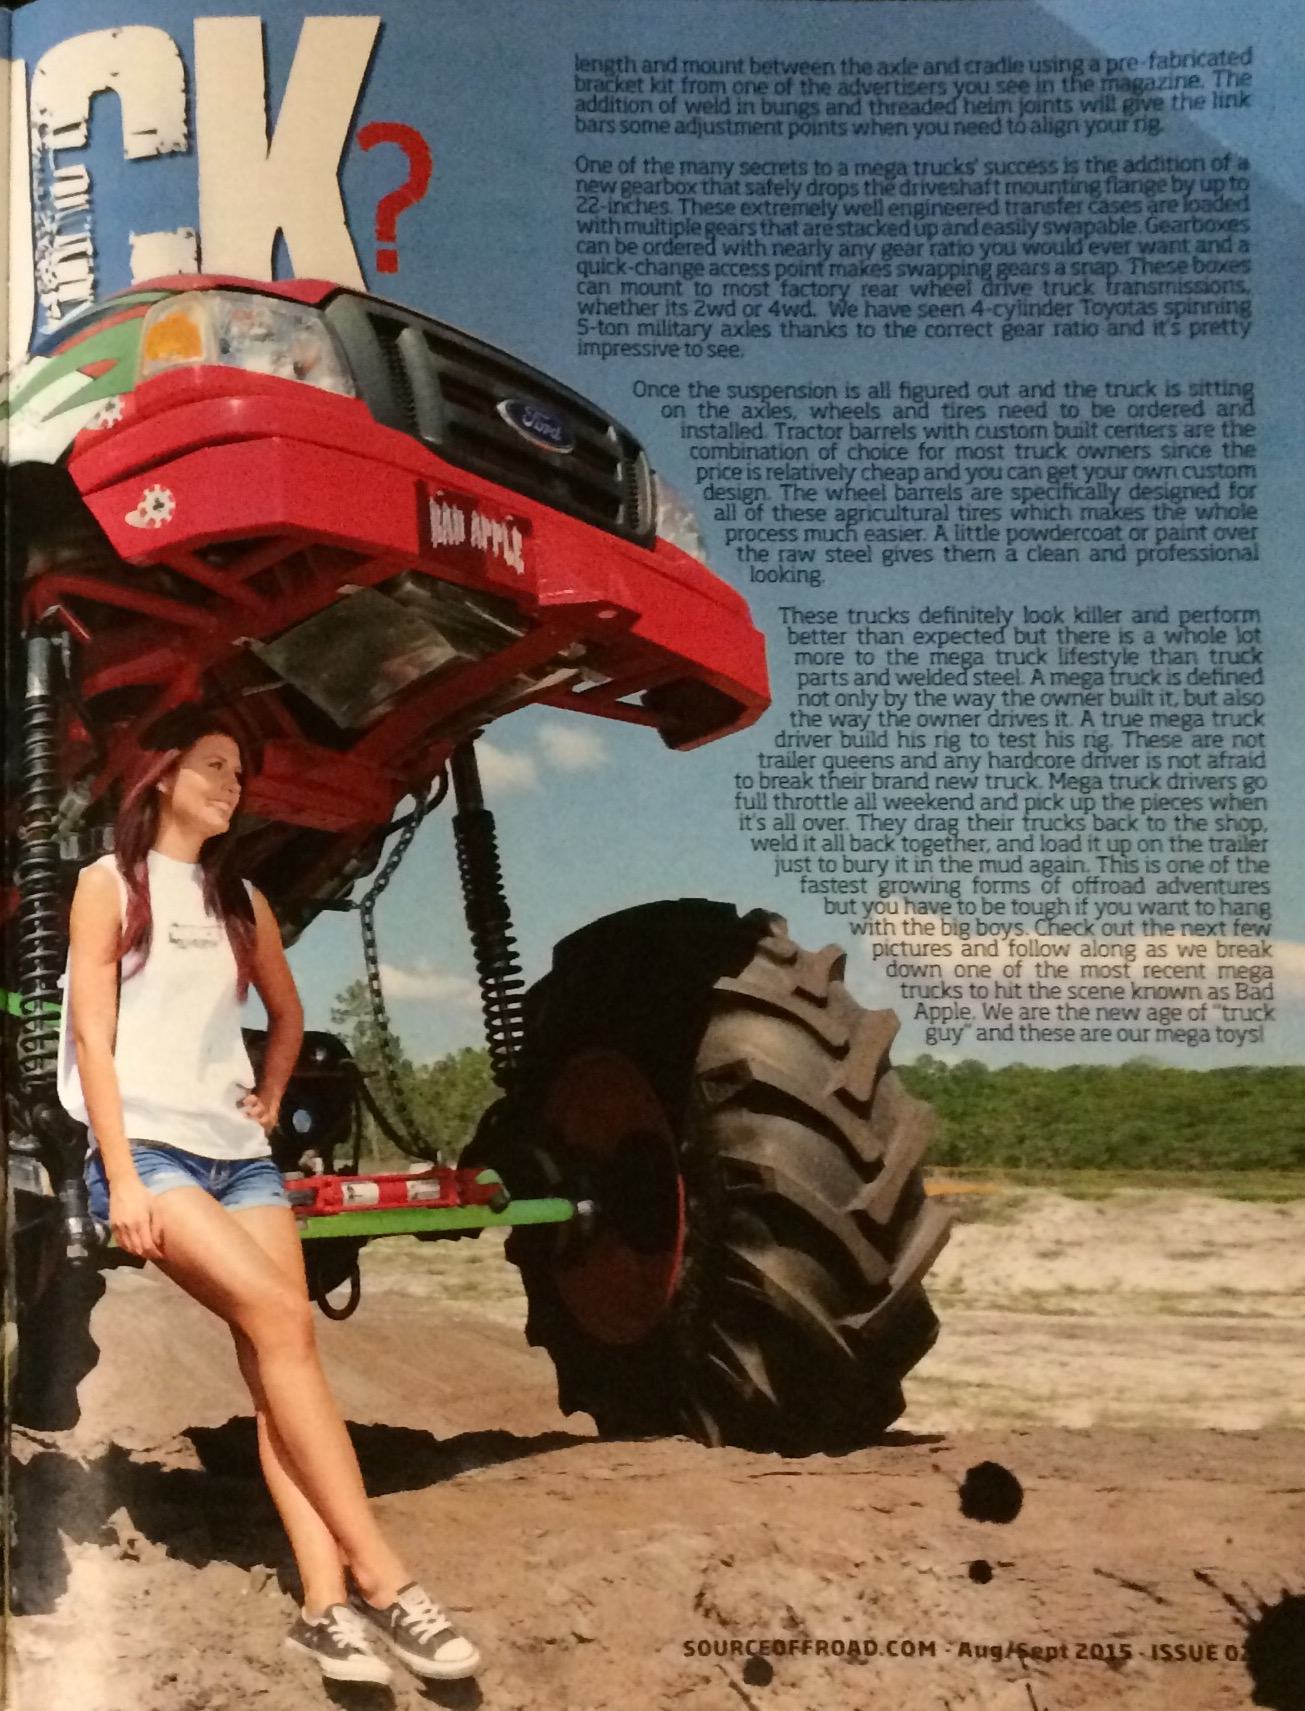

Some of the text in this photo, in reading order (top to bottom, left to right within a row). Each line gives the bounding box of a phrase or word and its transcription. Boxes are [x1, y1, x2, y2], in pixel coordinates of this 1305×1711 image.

[574, 54, 637, 77] length
[641, 57, 679, 73] and
[682, 58, 745, 74] mount
[749, 58, 835, 74] between
[841, 58, 873, 75] the
[878, 58, 919, 75] axle
[924, 58, 960, 75] and
[964, 57, 1024, 74] cradle
[1029, 57, 1084, 78] using
[1088, 60, 1101, 72] a
[576, 298, 1252, 319] whether its 2wd or 4wd. We have seen 4-cylinder Toyotas spinning
[576, 341, 745, 362] impressive to see.
[688, 442, 1256, 460] combination of choice for most truck owners since the
[470, 509, 525, 575] APPLE
[724, 524, 1259, 546] process much easier. A little powdercoat or paint over
[778, 607, 1261, 628] These trucks definitely look killer and perform
[796, 669, 1264, 690] parts and welded steel. A mega truck is defined
[734, 794, 1268, 815] full throttle all weekend and pick up the pieces when
[799, 877, 1271, 898] fastest growing forms of offroad adventures
[900, 982, 1274, 1000] trucks to hit the scene known as Bad
[924, 1025, 1266, 1047] guy" and these are our mega toys!
[682, 1639, 936, 1658] SOURCEOFFROAD.COM
[957, 1641, 1069, 1663] Aug/Sept
[1075, 1642, 1132, 1661] 2015
[1151, 1643, 1218, 1662] ISSUE
